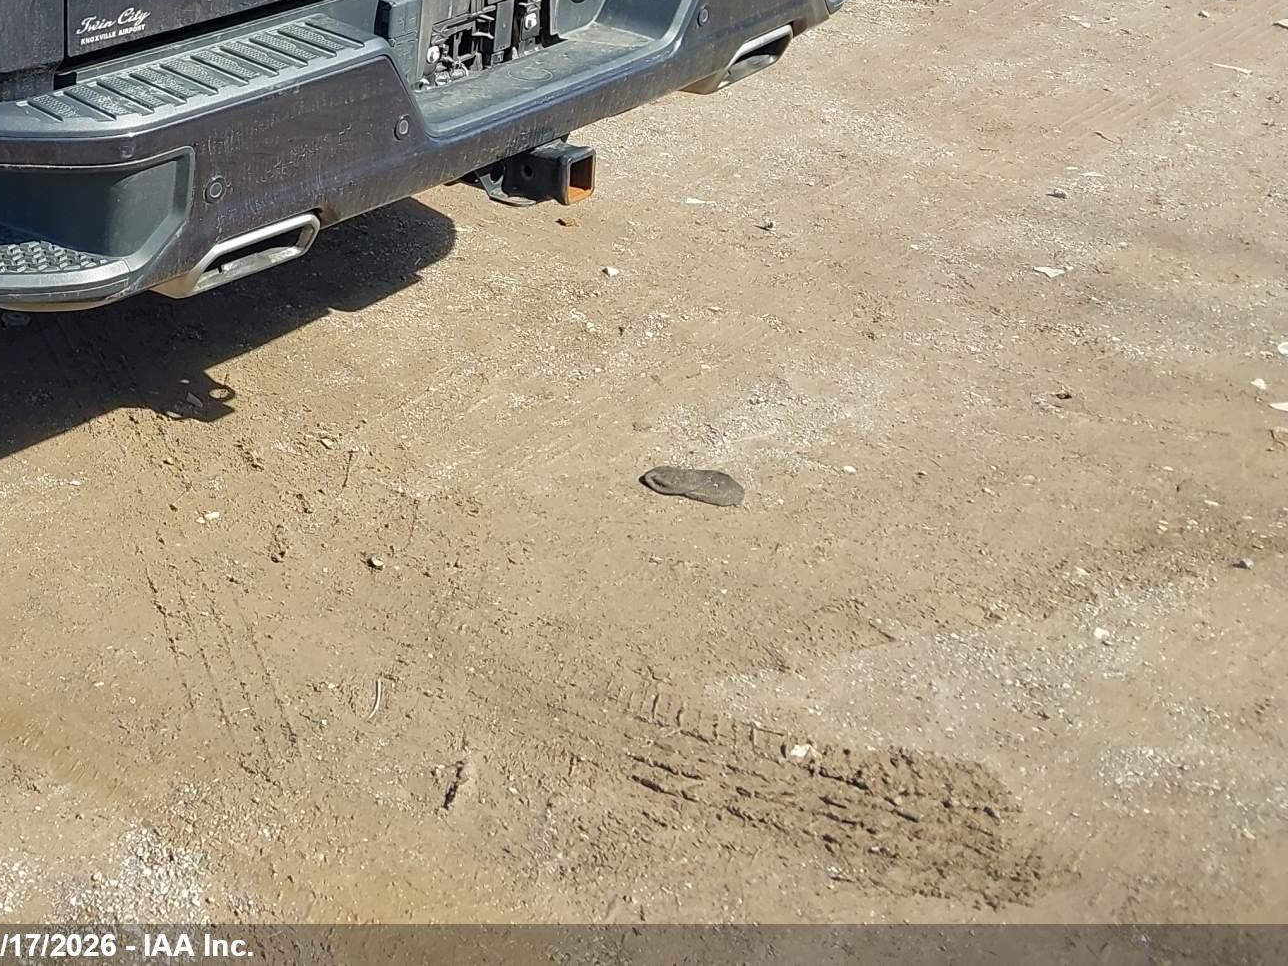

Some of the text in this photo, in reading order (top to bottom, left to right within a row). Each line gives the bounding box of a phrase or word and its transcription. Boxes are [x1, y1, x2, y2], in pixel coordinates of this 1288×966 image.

[76, 7, 151, 35] Twin City
[80, 24, 146, 46] KNOXVILLE AIRPORT
